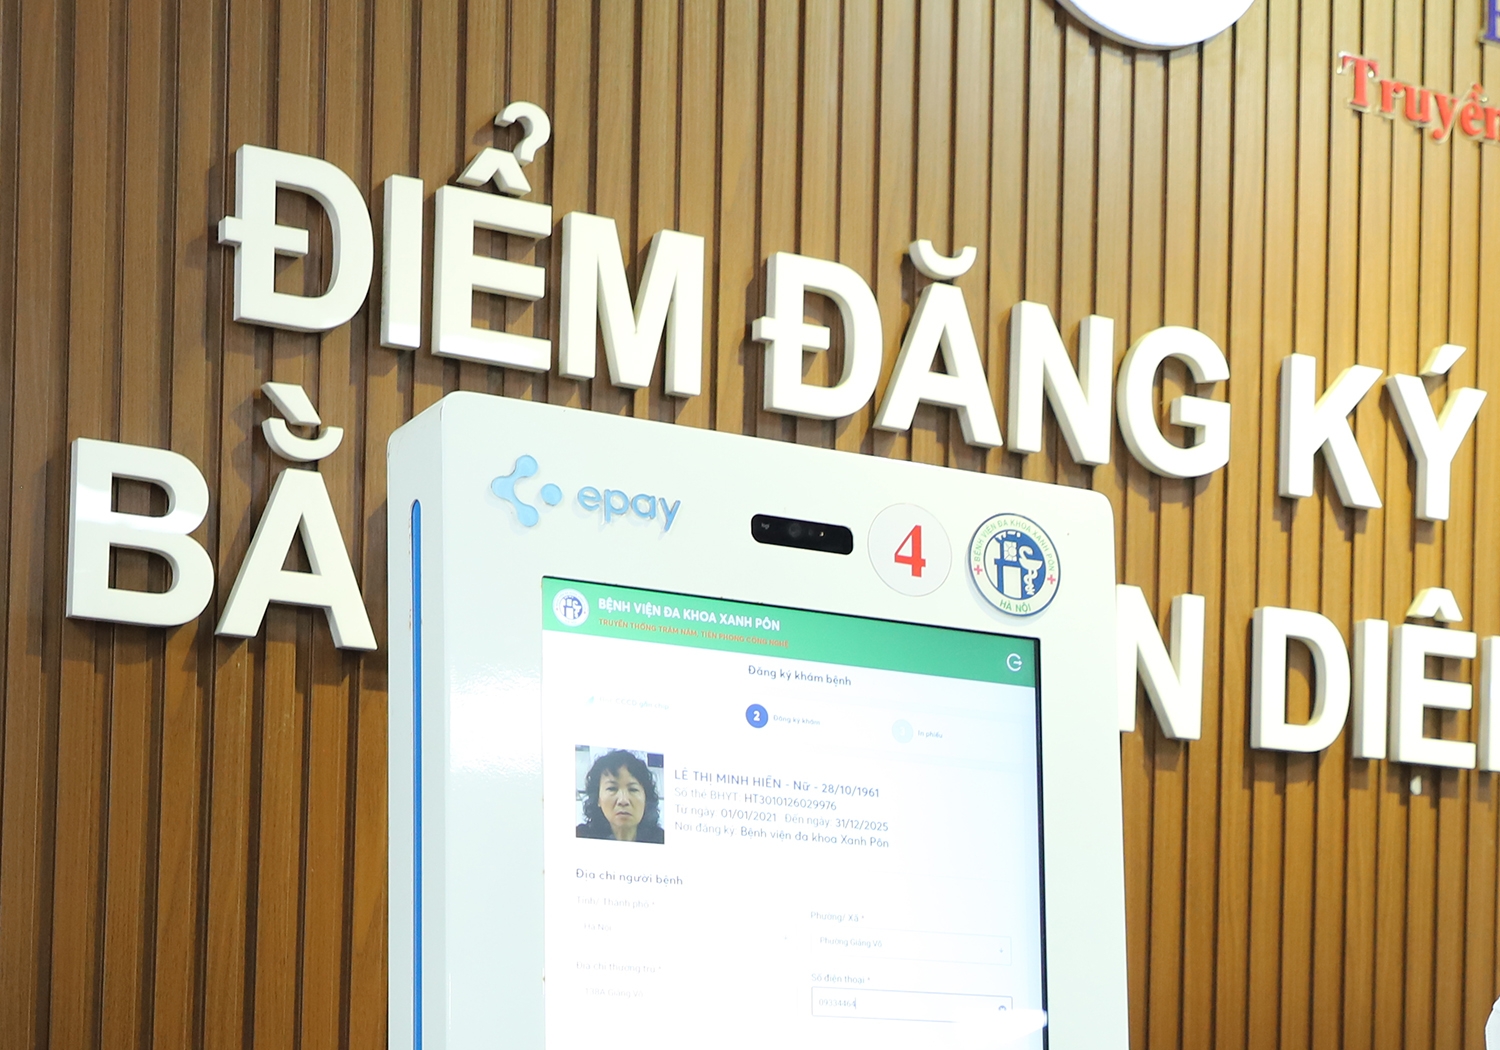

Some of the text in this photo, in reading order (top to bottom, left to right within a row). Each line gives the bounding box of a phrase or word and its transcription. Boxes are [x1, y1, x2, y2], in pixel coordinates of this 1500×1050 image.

[218, 101, 705, 399] ĐIỂM
[751, 239, 1231, 480] ĐĂNG
[1278, 343, 1488, 522] KÝ
[576, 480, 682, 533] epay
[893, 524, 927, 579] 4
[598, 597, 780, 631] BỆNH VIỆN ĐA KHOA XANH PÔN
[719, 633, 744, 642] PHONG
[747, 634, 767, 645] CÔNG
[748, 664, 851, 687] Đăng ký khám bệnh
[753, 711, 760, 721] 2
[674, 767, 688, 781] LÊ
[693, 771, 712, 786] THỊ
[717, 773, 749, 786] MINH
[793, 780, 810, 792] Nữ
[821, 783, 880, 798] 28/10/1961
[744, 793, 837, 811] HT3010126029976
[720, 809, 777, 823] 01/01/2021
[835, 818, 889, 832] 31/12/2025
[740, 826, 767, 840] Bệnh
[771, 828, 791, 843] viện
[794, 830, 808, 842] đa
[811, 832, 837, 844] khoa
[841, 834, 867, 846] Xanh
[870, 836, 889, 848] Pôn
[576, 868, 595, 882] Địa
[620, 872, 652, 885] người
[656, 874, 683, 887] bệnh
